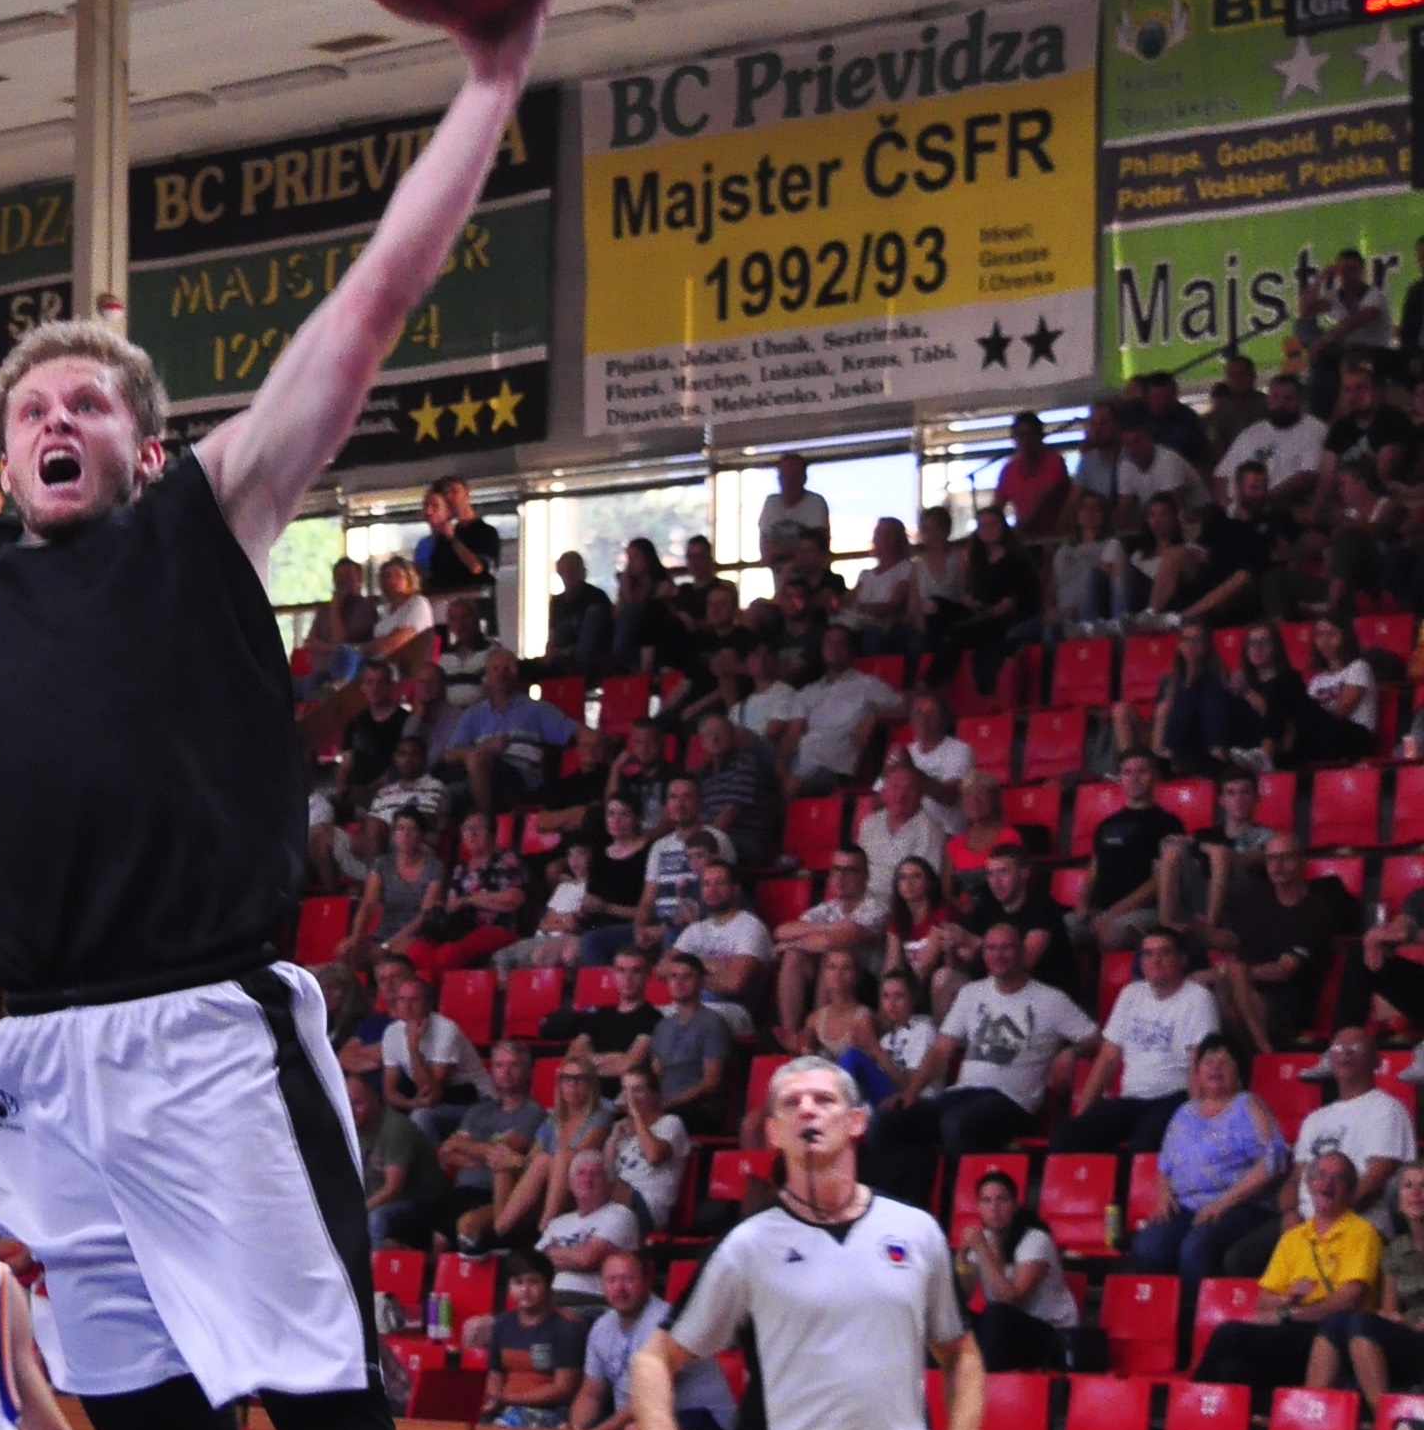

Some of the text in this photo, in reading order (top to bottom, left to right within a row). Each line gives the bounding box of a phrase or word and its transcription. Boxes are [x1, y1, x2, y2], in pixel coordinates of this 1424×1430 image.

[610, 11, 1067, 149] BC Prievidza
[153, 111, 527, 231] BC PRIEVIA
[612, 108, 1056, 244] Majster ČSFR
[705, 227, 949, 321] 1992/93
[1120, 244, 1401, 359] Majstr
